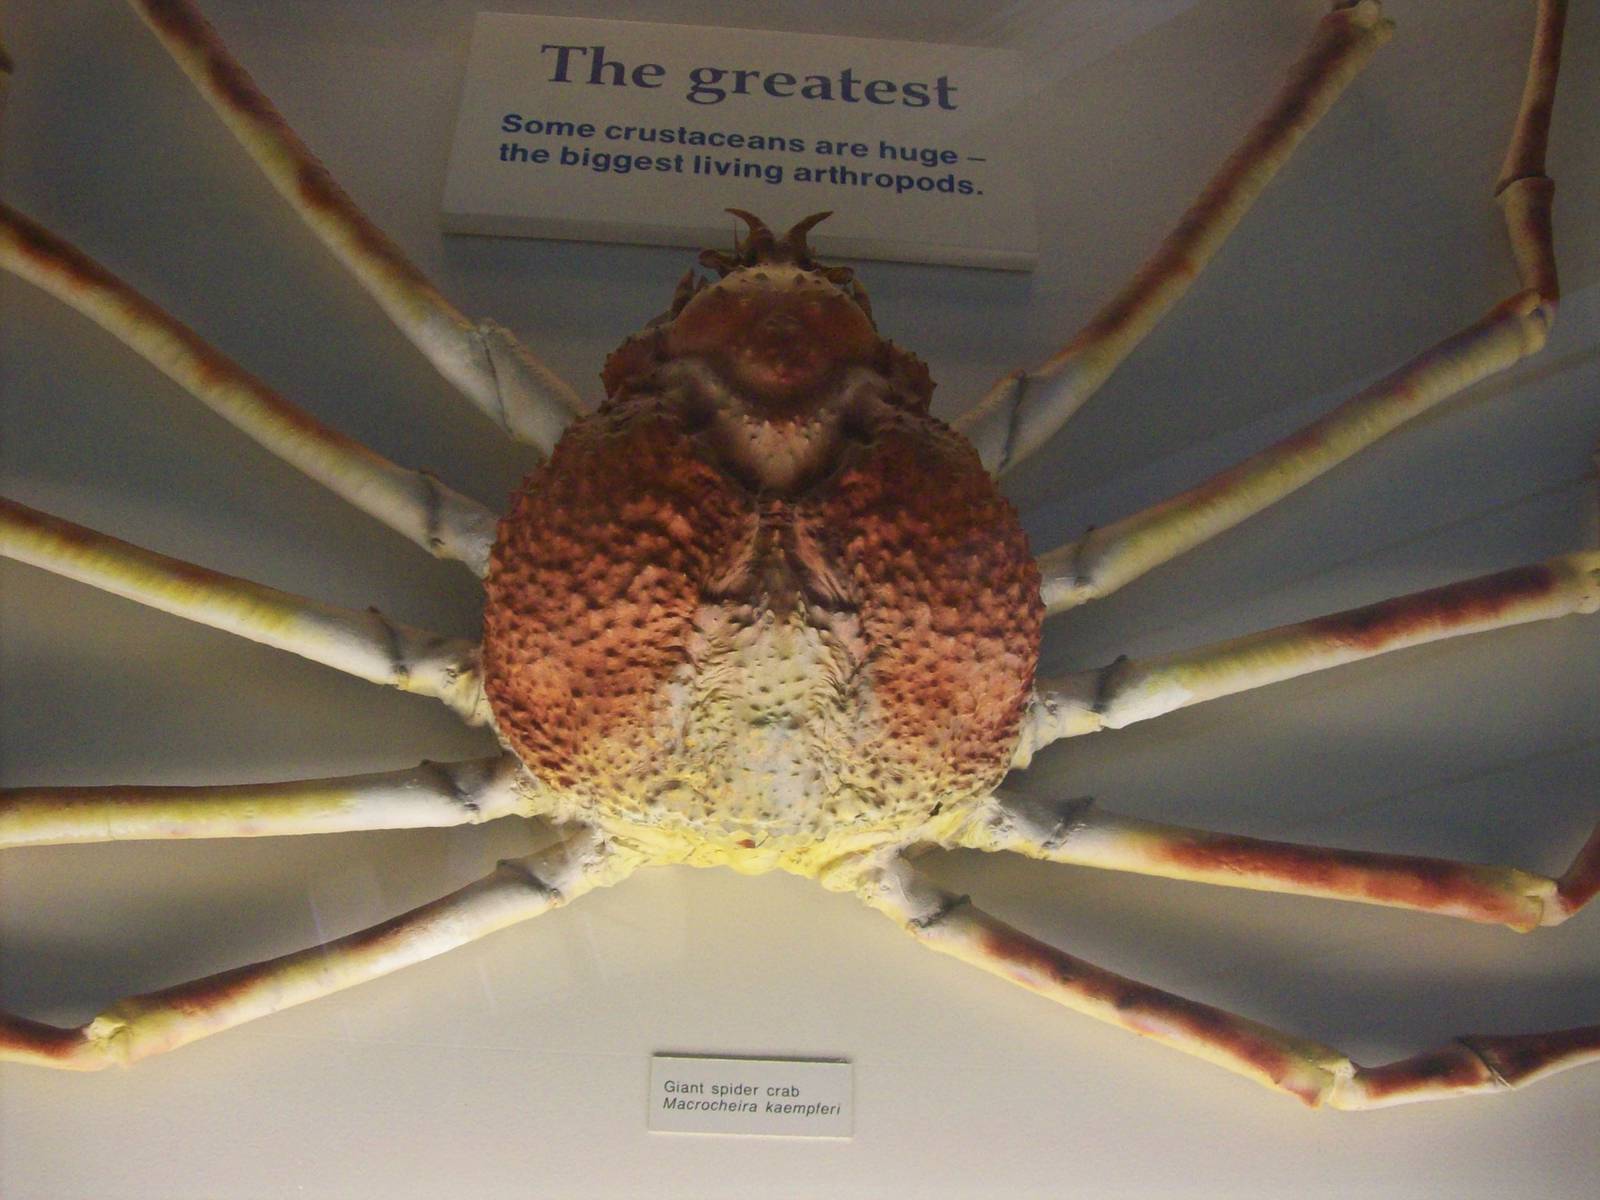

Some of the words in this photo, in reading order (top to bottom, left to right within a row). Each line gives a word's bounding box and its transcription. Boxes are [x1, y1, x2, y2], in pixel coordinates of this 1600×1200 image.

[541, 44, 666, 89] The
[686, 66, 958, 110] greatest
[501, 113, 596, 139] Some
[604, 121, 805, 154] crustaceans
[815, 137, 869, 158] are
[879, 140, 958, 166] huge
[500, 143, 550, 164] the
[560, 146, 684, 174] biggest
[693, 155, 784, 184] living
[793, 164, 984, 196] arthropods.
[662, 1097, 758, 1113] Macrocheira
[765, 1101, 841, 1117] kaempferi
[664, 1080, 703, 1095] Giant
[711, 1082, 759, 1098] spider
[766, 1085, 800, 1098] crab
